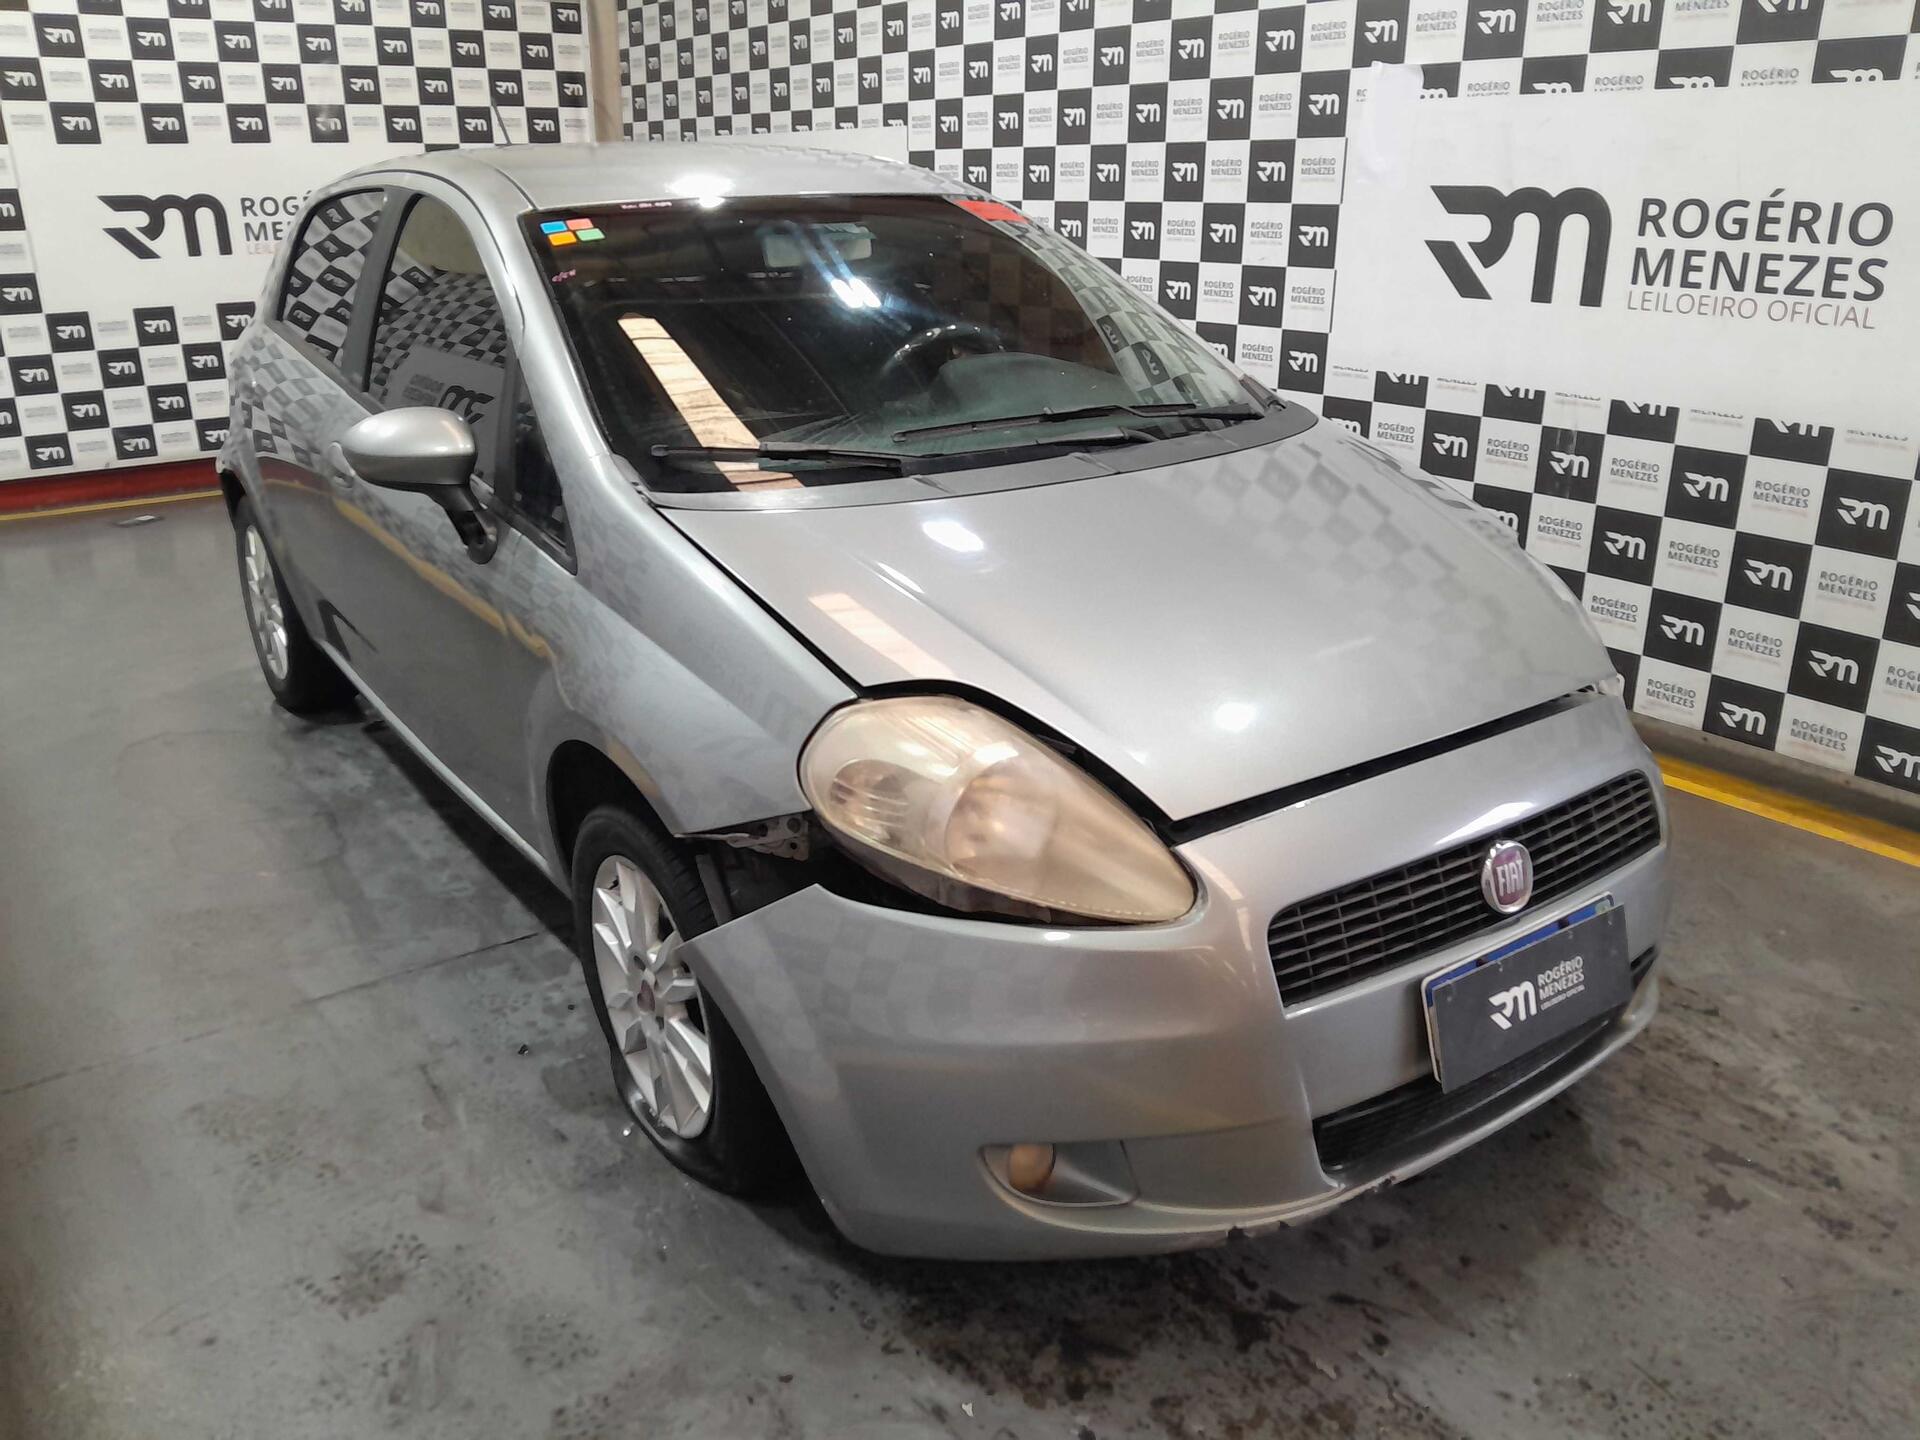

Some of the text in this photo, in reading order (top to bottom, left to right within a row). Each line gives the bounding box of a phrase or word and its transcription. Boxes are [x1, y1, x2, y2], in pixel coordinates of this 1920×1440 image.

[1595, 75, 1644, 86] ROGÉRIO
[1741, 67, 1799, 81] ROGÉRIO
[1467, 81, 1510, 92] ROGÉRIO
[1637, 188, 1894, 247] ROGÉRIO
[1630, 247, 1889, 301] MENEZES
[1626, 290, 1876, 330] LEILOEIRO OFICIAL
[1377, 422, 1415, 434] ROGÉRIO
[1377, 430, 1414, 445] MENEZES
[1487, 438, 1530, 452] ROGÉRIO
[1486, 447, 1528, 464] MENEZES
[1611, 457, 1660, 473] ROGÉRIO
[1610, 467, 1658, 483] MENEZES
[1755, 480, 1810, 498] ROGÉRIO
[1753, 491, 1808, 508] MENEZES
[1537, 524, 1582, 541] MENEZES
[1538, 515, 1583, 531] ROGÉRIO
[1669, 540, 1720, 559] ROGÉRIO
[1668, 550, 1719, 569] MENEZES
[1820, 571, 1878, 591] ROGÉRIO
[1818, 581, 1876, 602] MENEZES
[1592, 595, 1638, 613] ROGÉRIO
[1590, 605, 1637, 623] MENEZES
[1728, 637, 1781, 658] MENEZES
[1729, 628, 1783, 648] ROGÉRIO
[1647, 678, 1696, 699] ROGÉRIO
[1646, 688, 1695, 709] MENEZES
[1792, 718, 1848, 741] ROGÉRIO
[1790, 728, 1846, 751] MENEZES
[1496, 859, 1525, 897] FIAT
[1537, 956, 1583, 987] ROGÉRIO
[1539, 970, 1585, 1000] MENEZES
